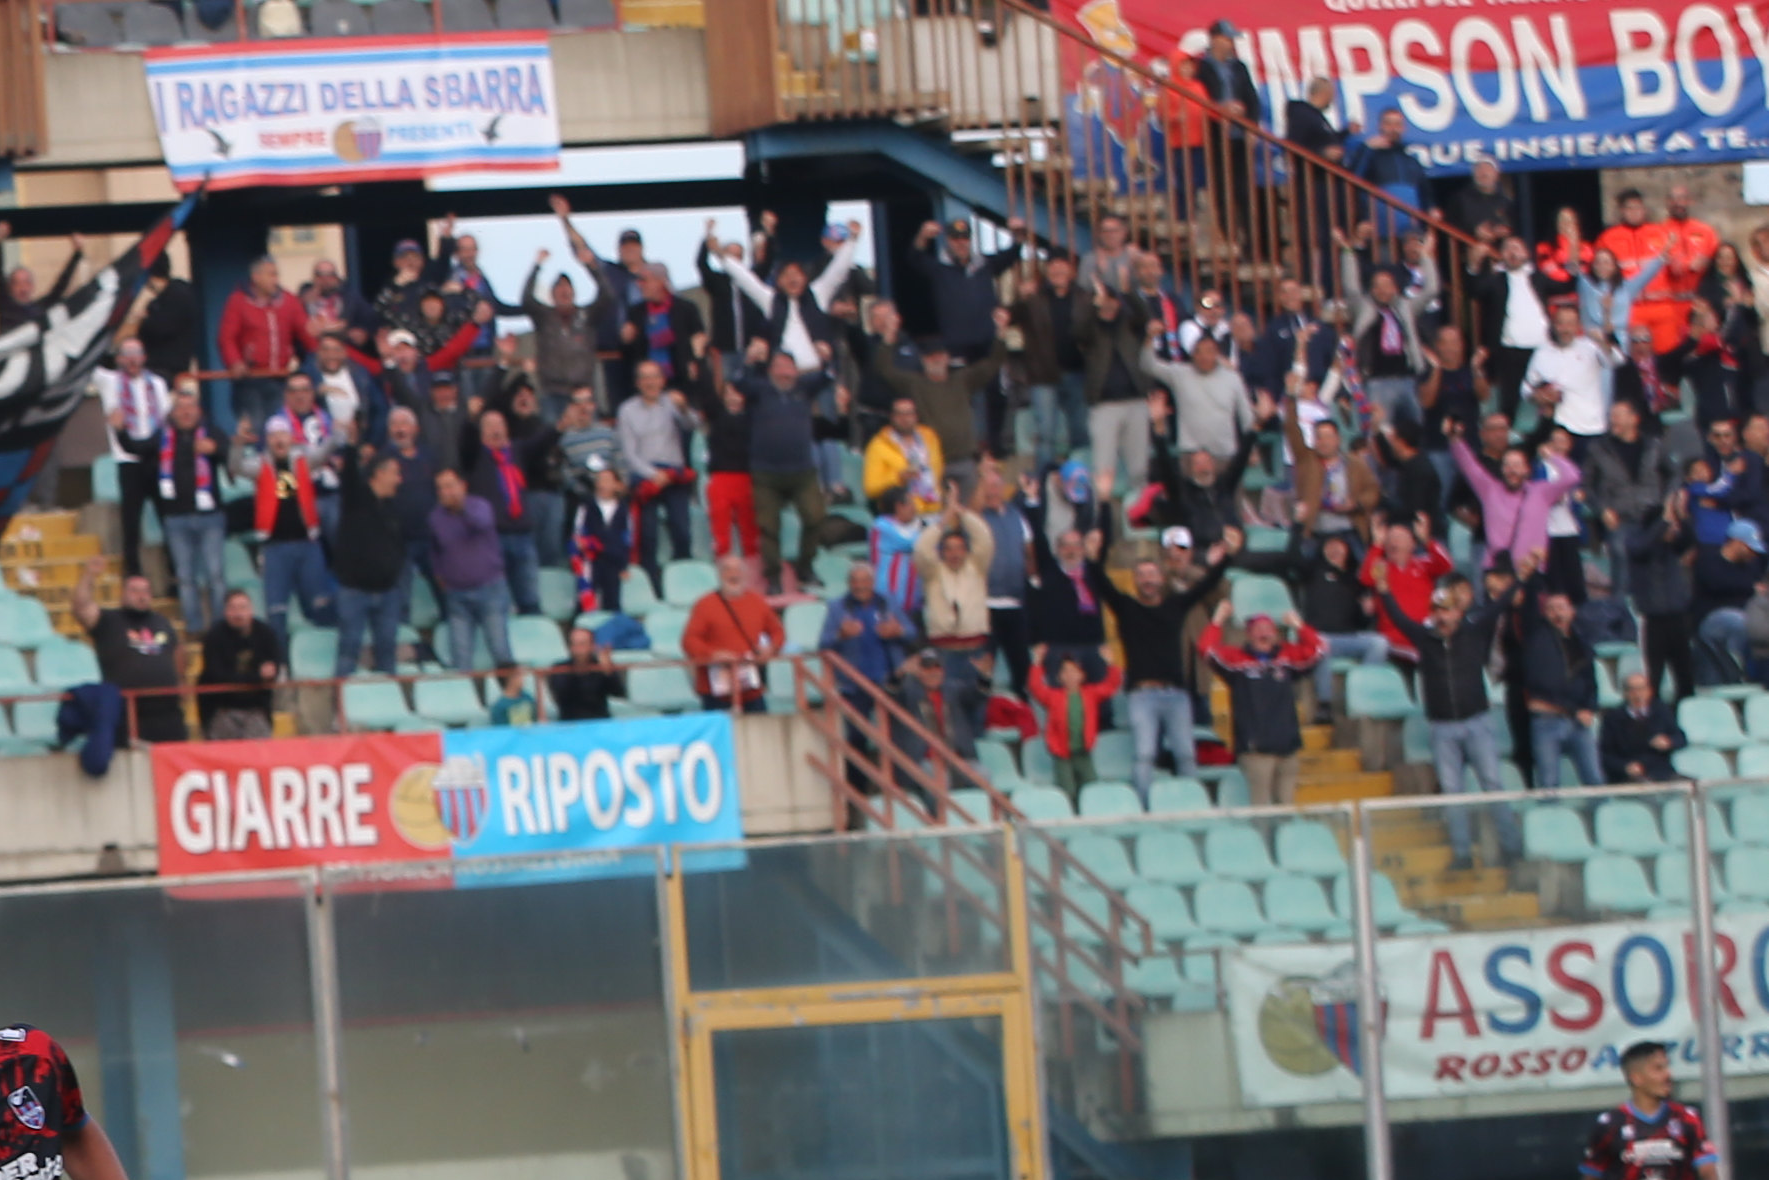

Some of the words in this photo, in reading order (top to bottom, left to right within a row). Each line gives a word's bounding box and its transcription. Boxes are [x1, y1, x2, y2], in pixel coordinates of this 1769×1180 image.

[177, 81, 308, 129] RAGAZZI
[321, 78, 415, 112] DELLA
[424, 64, 547, 115] SBARRA
[1494, 130, 1656, 161] INSIEME
[1663, 131, 1695, 152] A
[170, 763, 377, 855] GIARRE
[497, 740, 722, 836] RIPOSTO
